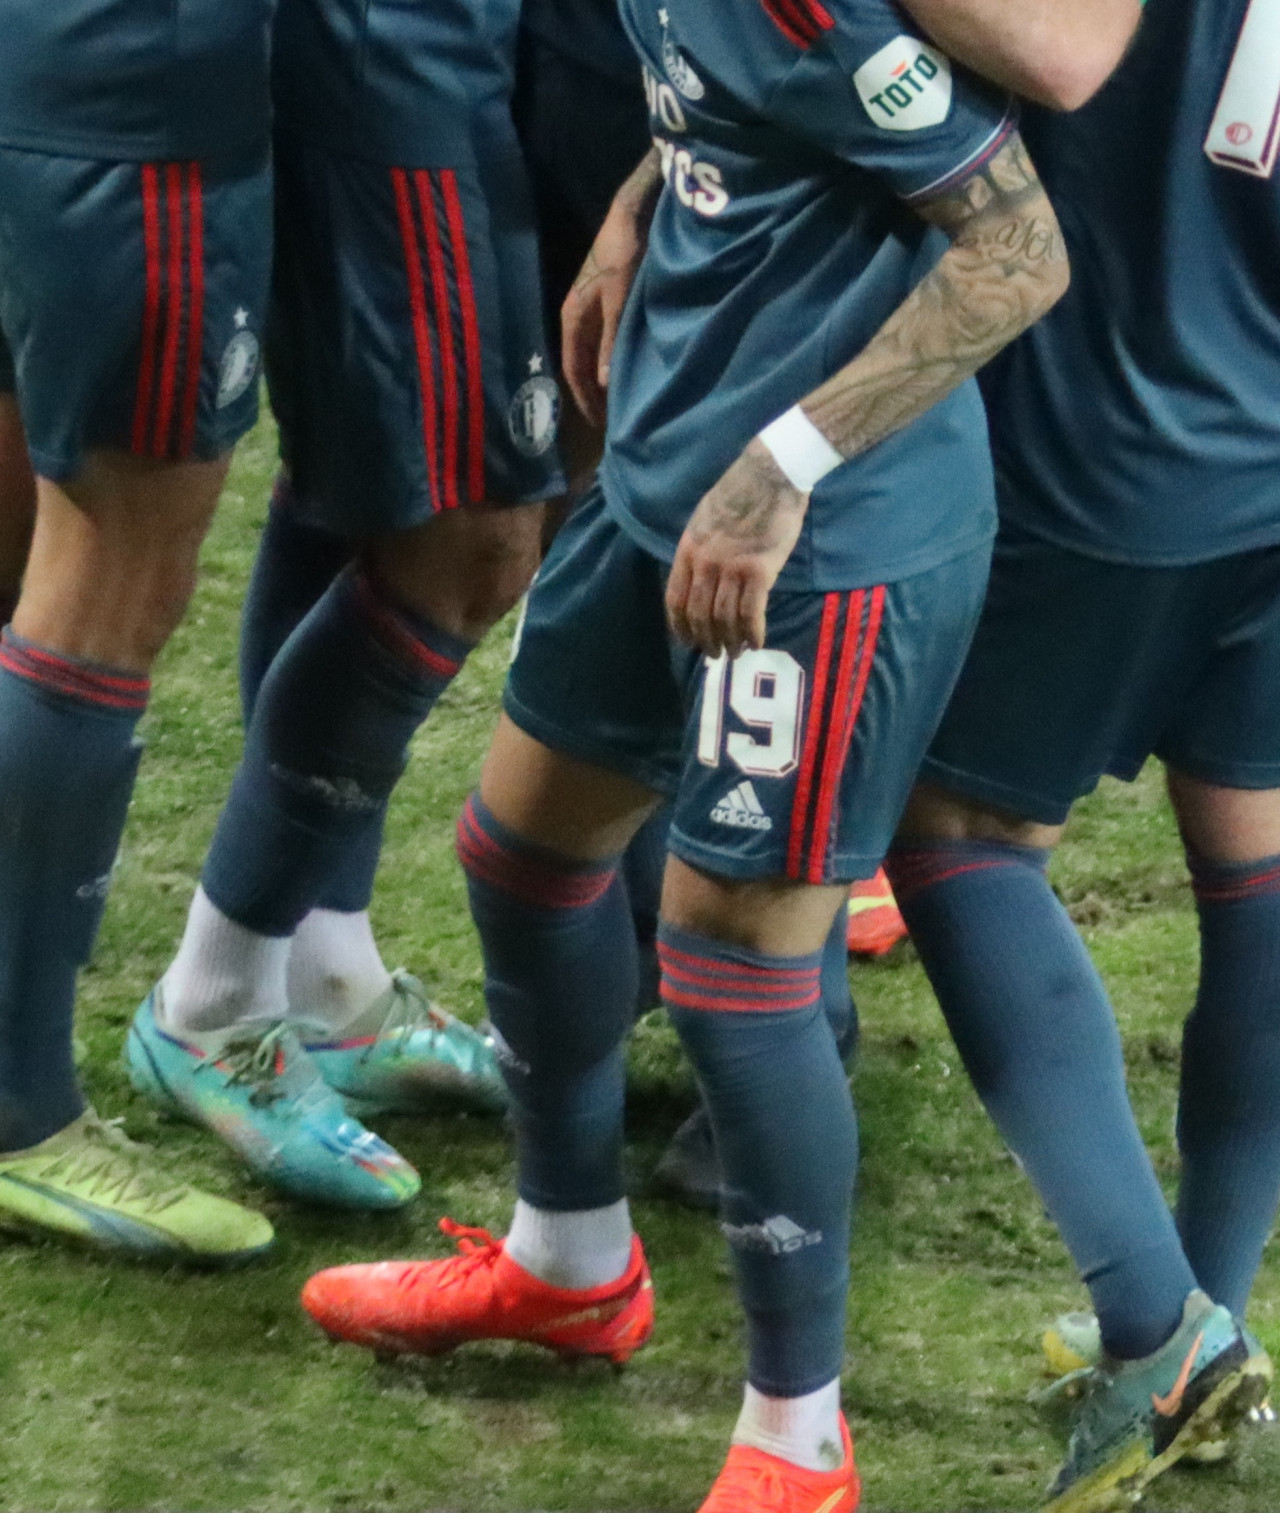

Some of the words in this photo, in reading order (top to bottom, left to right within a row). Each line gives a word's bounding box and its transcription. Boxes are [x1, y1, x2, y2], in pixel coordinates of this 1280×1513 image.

[868, 53, 938, 117] TOTO
[697, 645, 805, 779] 19
[709, 806, 772, 830] adidas
